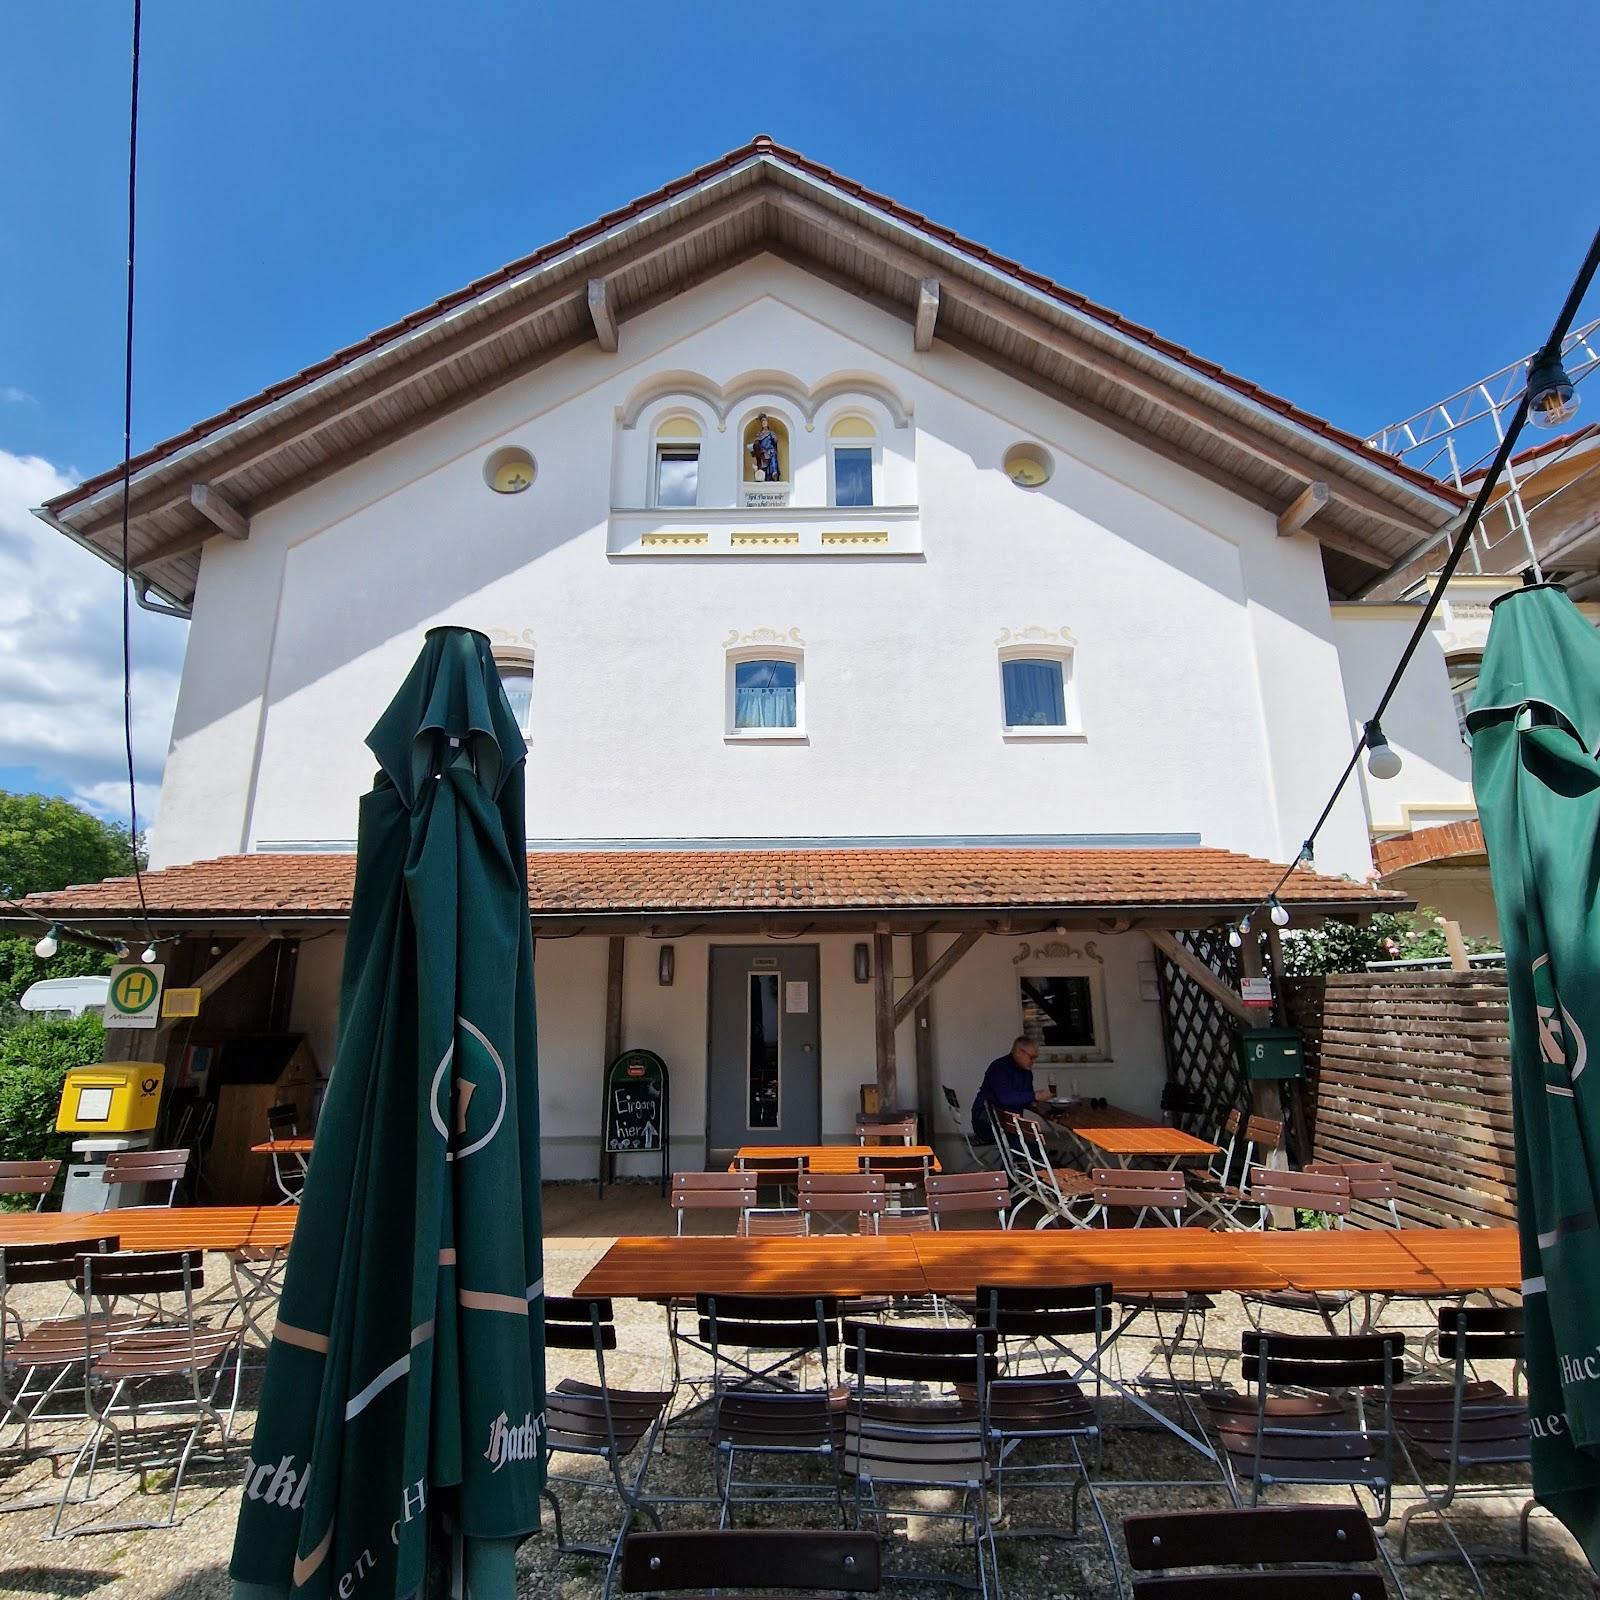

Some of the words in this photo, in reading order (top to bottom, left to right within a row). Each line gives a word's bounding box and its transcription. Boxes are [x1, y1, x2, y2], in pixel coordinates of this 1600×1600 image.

[124, 977, 146, 1003] H
[1255, 1044, 1265, 1059] 6
[615, 1119, 642, 1138] hier
[1560, 1345, 1600, 1384] Hac
